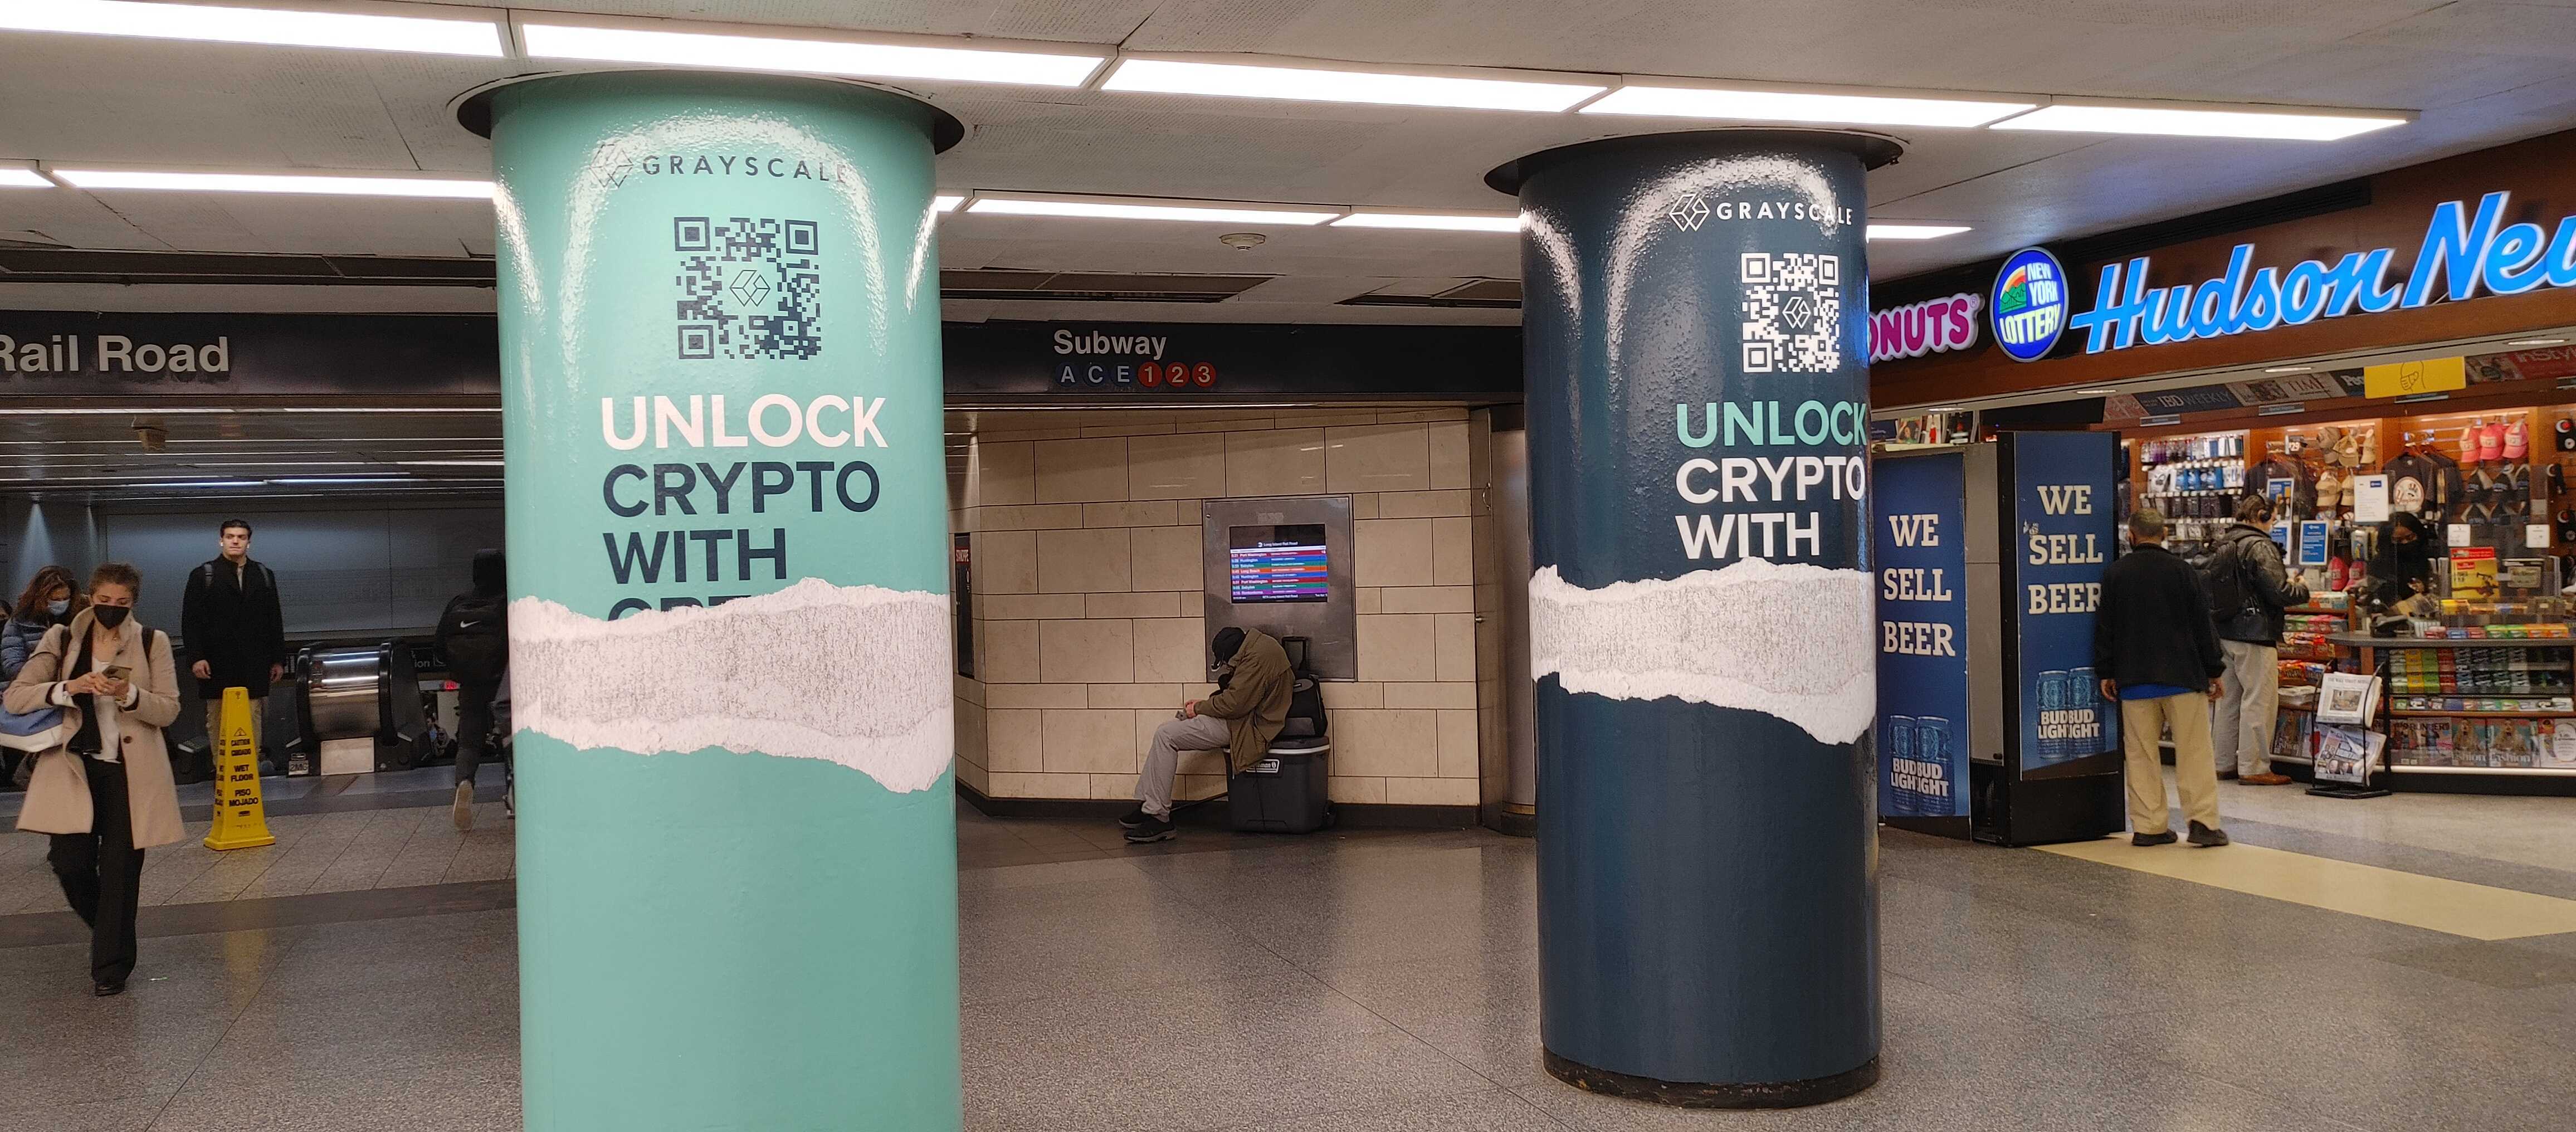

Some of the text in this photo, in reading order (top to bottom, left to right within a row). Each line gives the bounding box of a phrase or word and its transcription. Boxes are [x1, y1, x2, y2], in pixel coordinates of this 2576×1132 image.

[642, 154, 846, 182] GRAYSCALE
[1716, 202, 1852, 226] GRAYSCALE
[2027, 262, 2052, 281] NEW
[2028, 280, 2058, 307] YORK
[2070, 243, 2405, 355] Hudson
[1999, 303, 2062, 345] LOTTERY
[97, 335, 230, 373] Road
[1053, 329, 1167, 360] Subway
[1061, 365, 1211, 383] A C E 1 2 3
[2182, 391, 2232, 406] WEEKLY
[602, 393, 889, 451] UNLOCK
[1676, 400, 1867, 448] UNLOCK
[603, 461, 880, 518] CRYPTO
[1675, 456, 1866, 504] CRYPTO
[2037, 485, 2092, 515] WE
[1675, 511, 1820, 560] WITH
[1889, 513, 1939, 548] WE
[602, 528, 787, 585] WITH
[2029, 533, 2104, 565] SELL
[1883, 568, 1952, 602] SELL
[1883, 621, 1956, 657] BEER
[2040, 710, 2068, 725] BUD
[2067, 709, 2095, 724] BUD
[231, 773, 253, 782] FLOOR
[233, 764, 250, 773] WET
[1892, 757, 1918, 776] BUD
[1916, 761, 1943, 780] BUD
[228, 797, 258, 807] MOJADO
[235, 788, 251, 797] PISO
